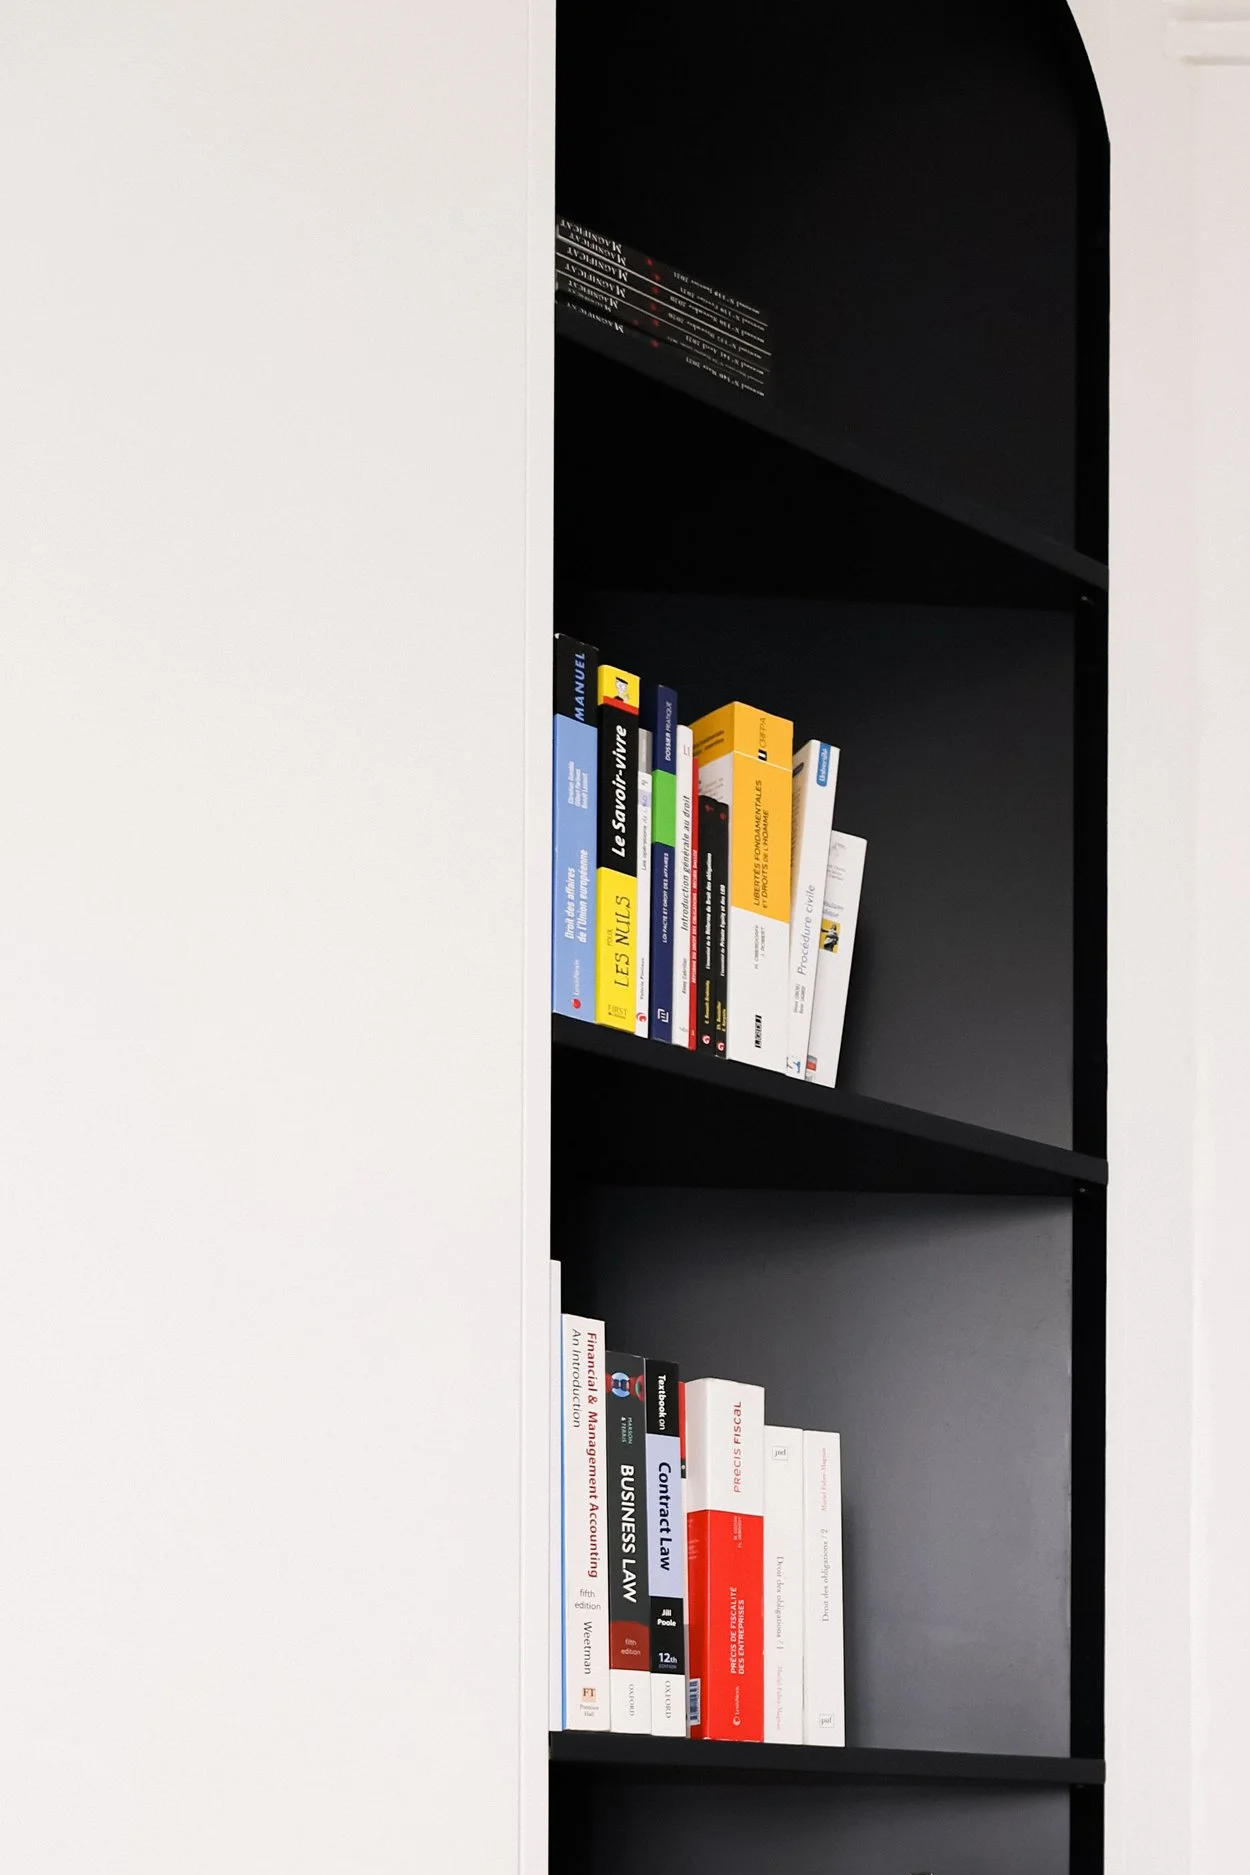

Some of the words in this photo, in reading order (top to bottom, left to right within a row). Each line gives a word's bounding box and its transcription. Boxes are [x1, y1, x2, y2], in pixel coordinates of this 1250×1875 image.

[560, 220, 622, 254] MAGNIFICAT
[569, 232, 626, 266] MAGNIFICAT
[566, 246, 628, 281] MAGNIFICAT
[565, 263, 626, 298] MAGNIFICAT
[568, 280, 618, 308] MAGNIFICAT
[567, 302, 624, 334] MAGNIFICAT
[575, 652, 586, 722] MANUEL
[665, 700, 673, 732] PRATIQUE
[664, 732, 672, 761] DOSSIER
[611, 724, 628, 834] Savoir-vivre
[682, 795, 690, 816] droit
[754, 779, 763, 861] FONDAMENTALES
[684, 819, 690, 831] au
[611, 835, 626, 858] Le
[681, 832, 692, 873] générale
[564, 867, 576, 900] affaires
[580, 849, 591, 900] européenne
[753, 863, 762, 907] LIBERTÉS
[565, 901, 575, 917] des
[578, 901, 588, 929] l'Union
[680, 875, 690, 931] Introduction
[803, 884, 816, 915] civile
[564, 918, 576, 939] Droit
[577, 930, 588, 943] de
[614, 895, 632, 946] NULS
[797, 916, 812, 976] Procédure
[614, 952, 631, 988] LES
[572, 1329, 582, 1346] An
[587, 1332, 598, 1392] Financial
[572, 1349, 582, 1428] Introduction
[587, 1395, 598, 1405] &
[658, 1375, 667, 1418] Textbook
[659, 1418, 666, 1430] on
[586, 1411, 599, 1499] Management
[620, 1464, 636, 1554] BUSINESS
[659, 1461, 673, 1533] Contract
[587, 1502, 600, 1578] Accounting
[659, 1537, 673, 1571] Law
[776, 1555, 785, 1577] Droit
[820, 1541, 831, 1584] obligations
[580, 1589, 596, 1599] fifth
[622, 1558, 637, 1603] LAW
[776, 1579, 784, 1592] des
[820, 1585, 829, 1599] des
[575, 1601, 602, 1611] edition
[661, 1608, 672, 1617] Jill
[729, 1587, 737, 1629] FISCALITÉ
[774, 1594, 784, 1638] obligations
[820, 1601, 829, 1622] Droit
[657, 1618, 677, 1628] Poole
[730, 1630, 736, 1643] DE
[583, 1621, 593, 1675] Weetman
[620, 1648, 641, 1656] edition
[658, 1652, 678, 1664] 12th
[729, 1644, 737, 1674] PRÉCIS
[583, 1688, 596, 1698] FT
[664, 1681, 672, 1719] OXFORD
